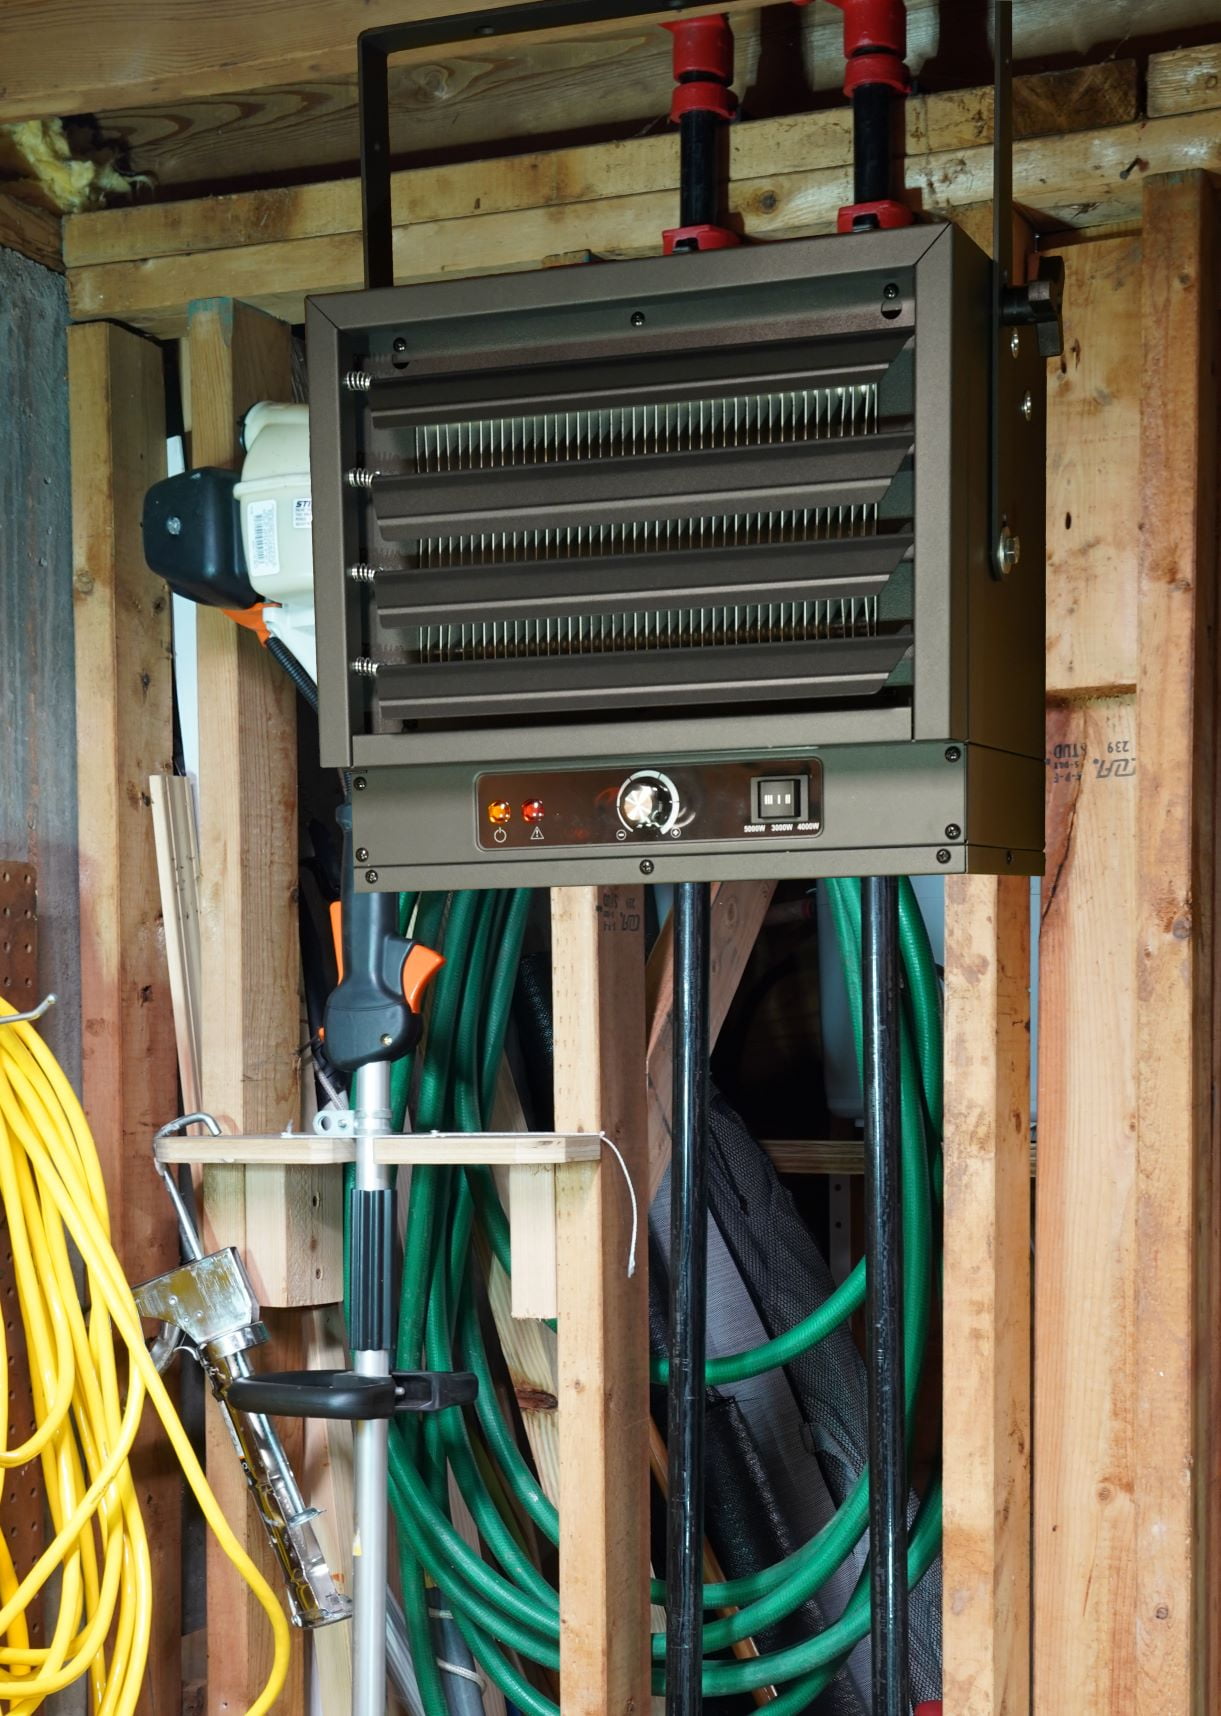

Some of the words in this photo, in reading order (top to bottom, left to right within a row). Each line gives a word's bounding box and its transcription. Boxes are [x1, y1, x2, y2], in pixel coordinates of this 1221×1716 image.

[1053, 743, 1087, 758] STUD
[1107, 740, 1129, 753] 239
[743, 825, 766, 833] 5000W
[771, 823, 793, 832] 3000W
[797, 822, 820, 830] 4000W
